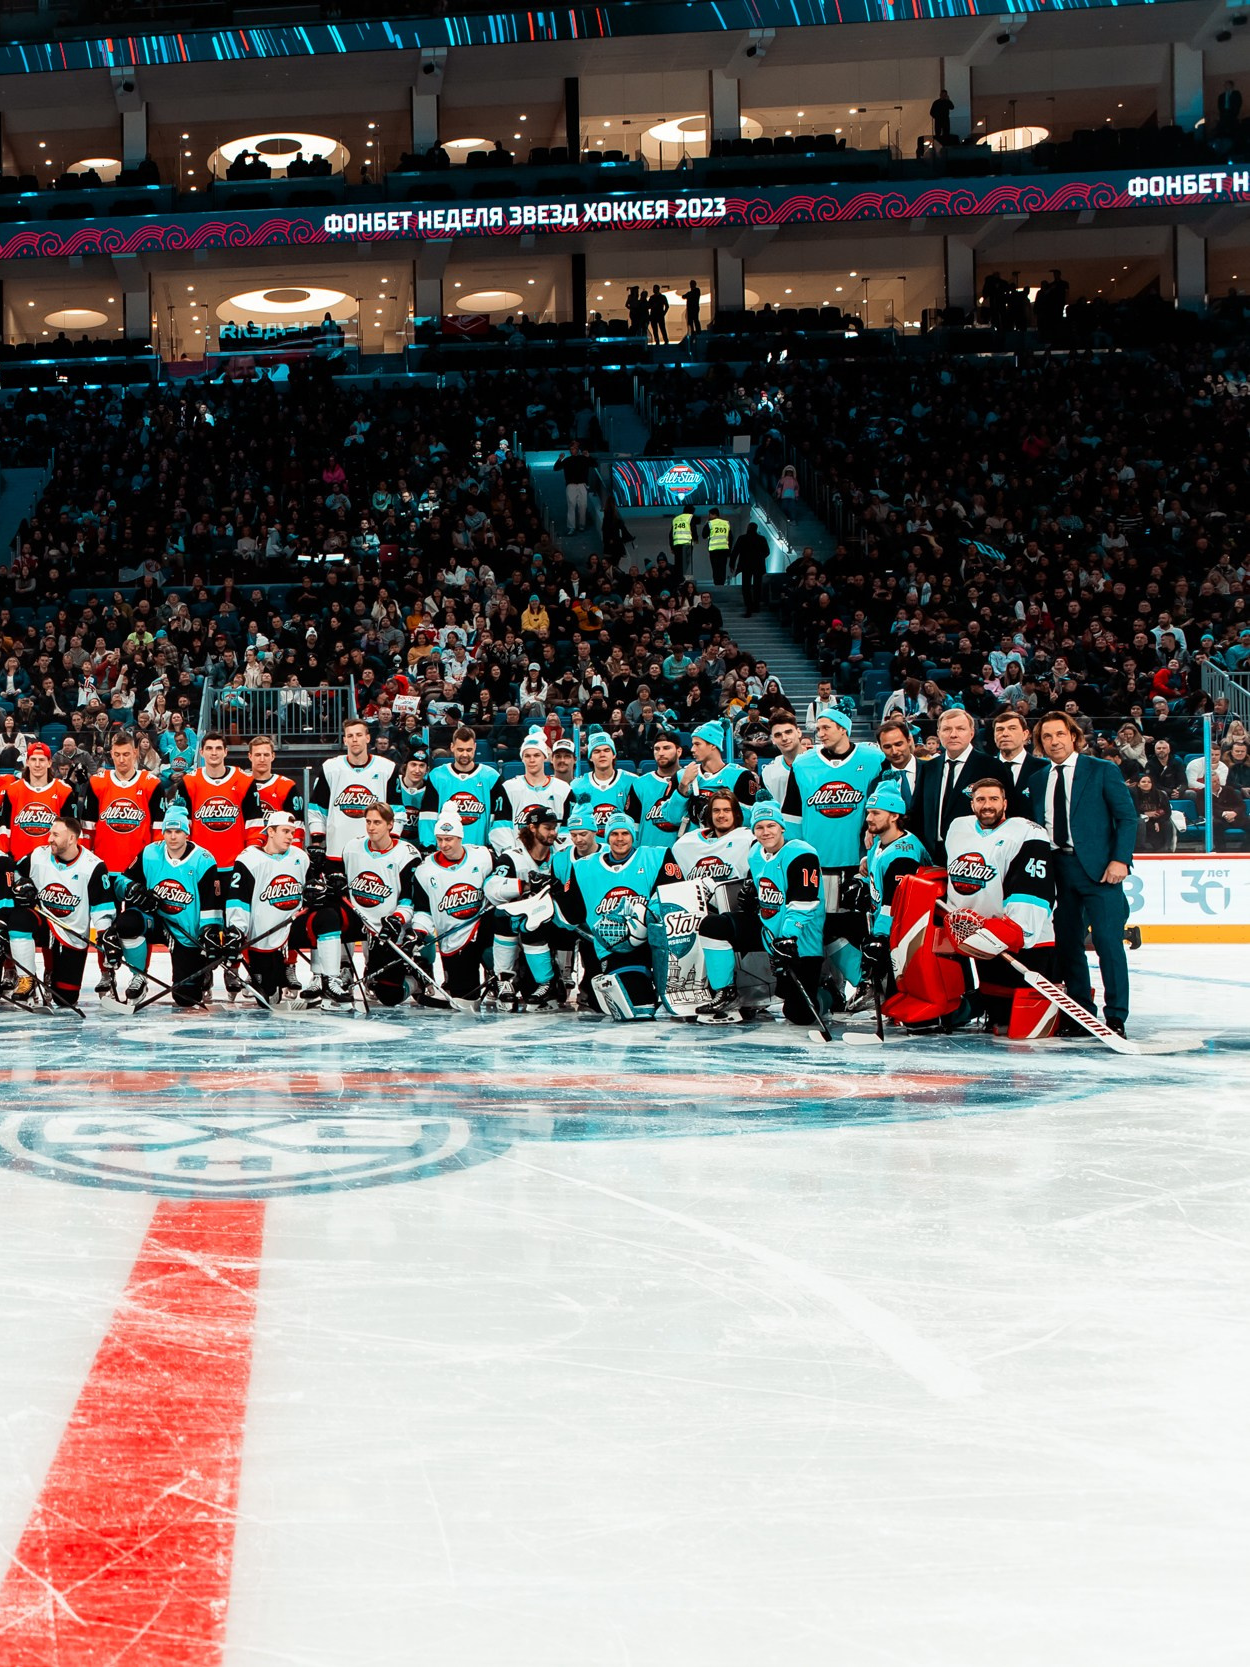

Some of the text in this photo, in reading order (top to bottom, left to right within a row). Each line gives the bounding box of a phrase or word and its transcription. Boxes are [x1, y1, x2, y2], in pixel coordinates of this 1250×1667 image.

[1128, 172, 1227, 197] ФОНБЕТ
[324, 197, 726, 234] ФОНБЕТ НЕДЕЛЯ ЗВЕЗД ХОККЕЯ 2023
[659, 472, 701, 483] All-Star
[334, 793, 378, 806] All-Star
[807, 789, 864, 805] All-Star
[15, 810, 57, 825] All-Star
[100, 806, 145, 821] All-Star
[195, 805, 239, 819] All-Star
[688, 863, 732, 880] All-Star
[948, 860, 997, 879] All-Star
[1025, 858, 1047, 878] 45
[1207, 869, 1230, 878] лет
[230, 872, 241, 888] 2
[802, 869, 818, 887] 14
[261, 881, 303, 901] All-Star
[350, 877, 391, 897] All-Star
[37, 890, 80, 906] All-Star
[438, 889, 484, 911] All-Star
[666, 913, 702, 936] Star
[1036, 981, 1113, 1038] WARRIOR
